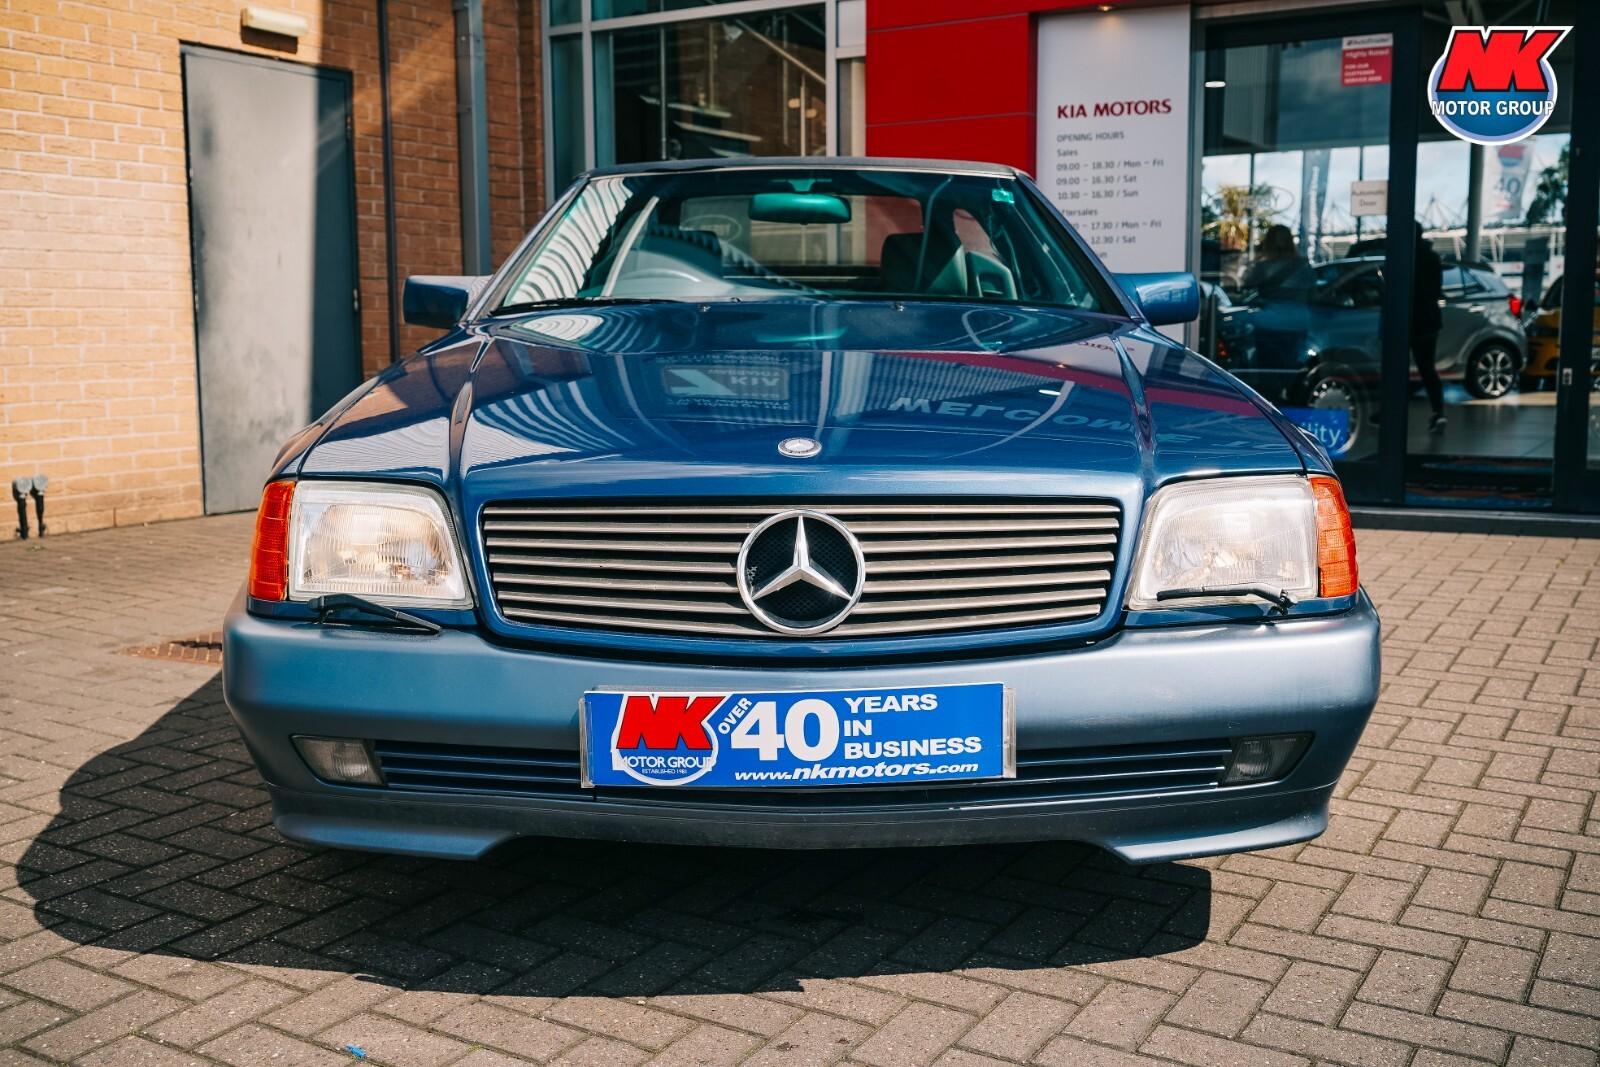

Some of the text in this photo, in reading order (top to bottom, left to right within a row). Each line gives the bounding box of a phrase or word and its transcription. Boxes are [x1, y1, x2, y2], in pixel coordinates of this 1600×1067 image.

[1057, 98, 1172, 119] KIA MOTORS
[1056, 131, 1125, 142] OPENING HOURS
[1056, 149, 1078, 158] Sales
[1056, 162, 1080, 172] 09.00
[1123, 159, 1142, 168] Mon
[1152, 158, 1164, 167] Fri
[1123, 174, 1137, 183] Sat
[1123, 189, 1138, 198] Sun
[1060, 208, 1098, 217] ftersales
[1121, 220, 1140, 229] Mon
[1150, 219, 1162, 228] Fri
[1123, 235, 1137, 244] Sat
[843, 693, 938, 714] YEARS
[615, 696, 727, 750] NK
[717, 697, 753, 735] OVER
[731, 699, 840, 763] 40
[843, 719, 873, 737] IN
[844, 736, 982, 760] BUSINESS
[667, 757, 713, 769] GROUP
[735, 761, 979, 781] www.nkmotors.com
